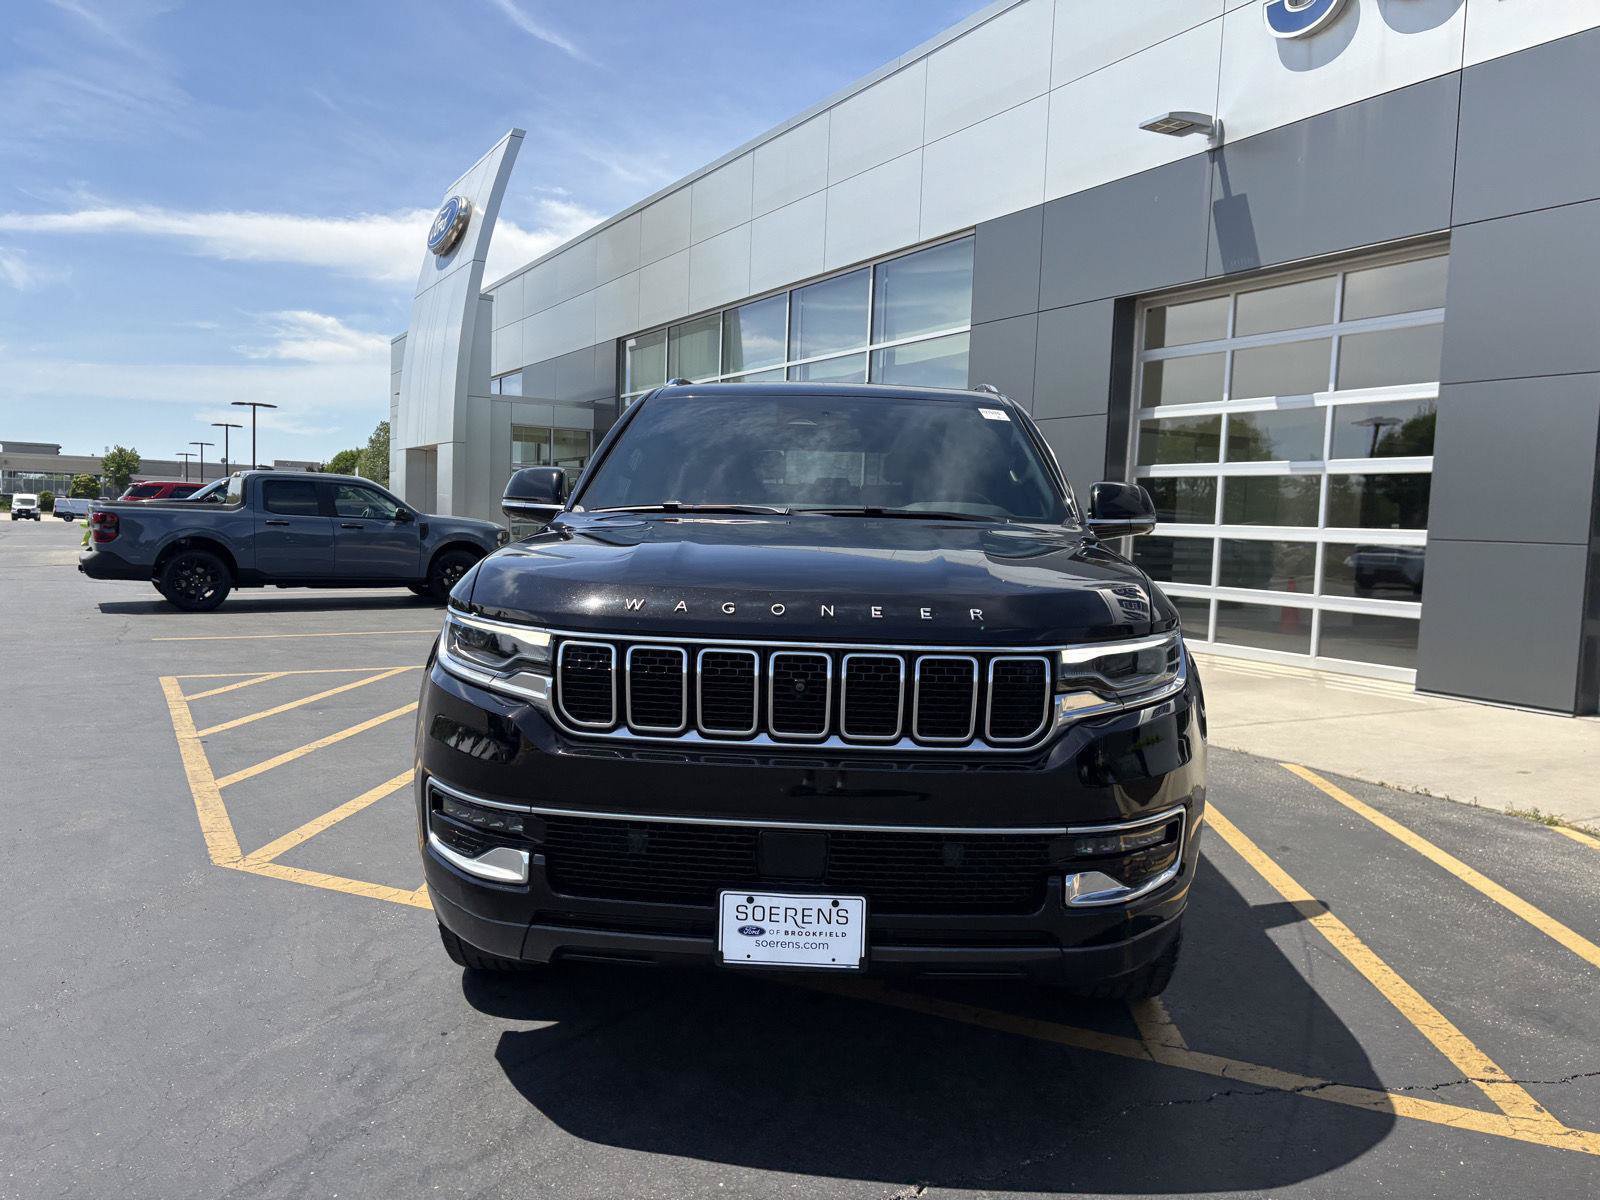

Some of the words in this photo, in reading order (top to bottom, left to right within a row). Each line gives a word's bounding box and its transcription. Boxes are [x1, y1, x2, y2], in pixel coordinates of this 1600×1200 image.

[624, 598, 984, 621] WAGONEER
[735, 904, 849, 929] SOERENS
[742, 926, 762, 936] Ford
[784, 930, 847, 938] BROOKFIELD
[754, 940, 829, 950] soerens.com
